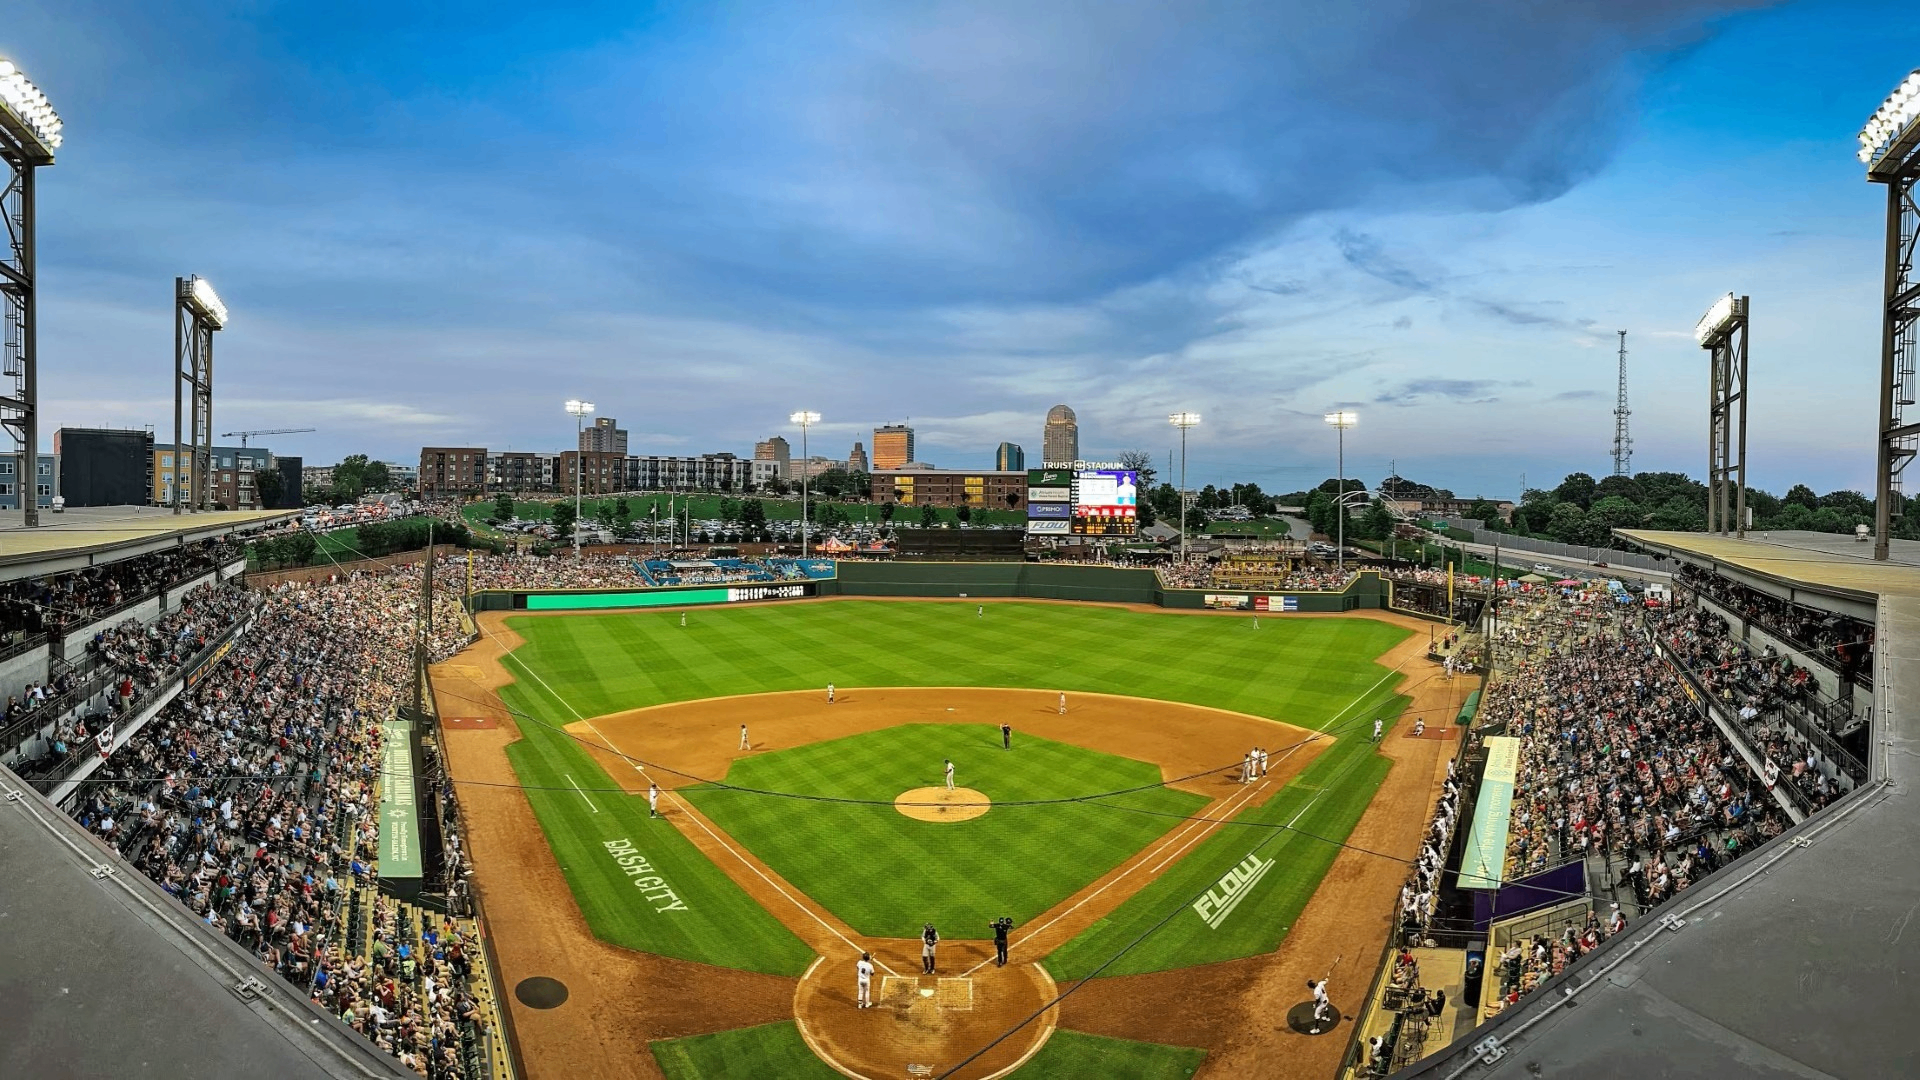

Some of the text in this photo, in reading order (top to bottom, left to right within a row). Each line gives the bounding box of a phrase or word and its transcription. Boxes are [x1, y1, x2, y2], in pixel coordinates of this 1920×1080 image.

[1043, 461, 1073, 469] TRUIST
[602, 838, 689, 914] DASH CITY
[1192, 853, 1264, 922] FLOW
